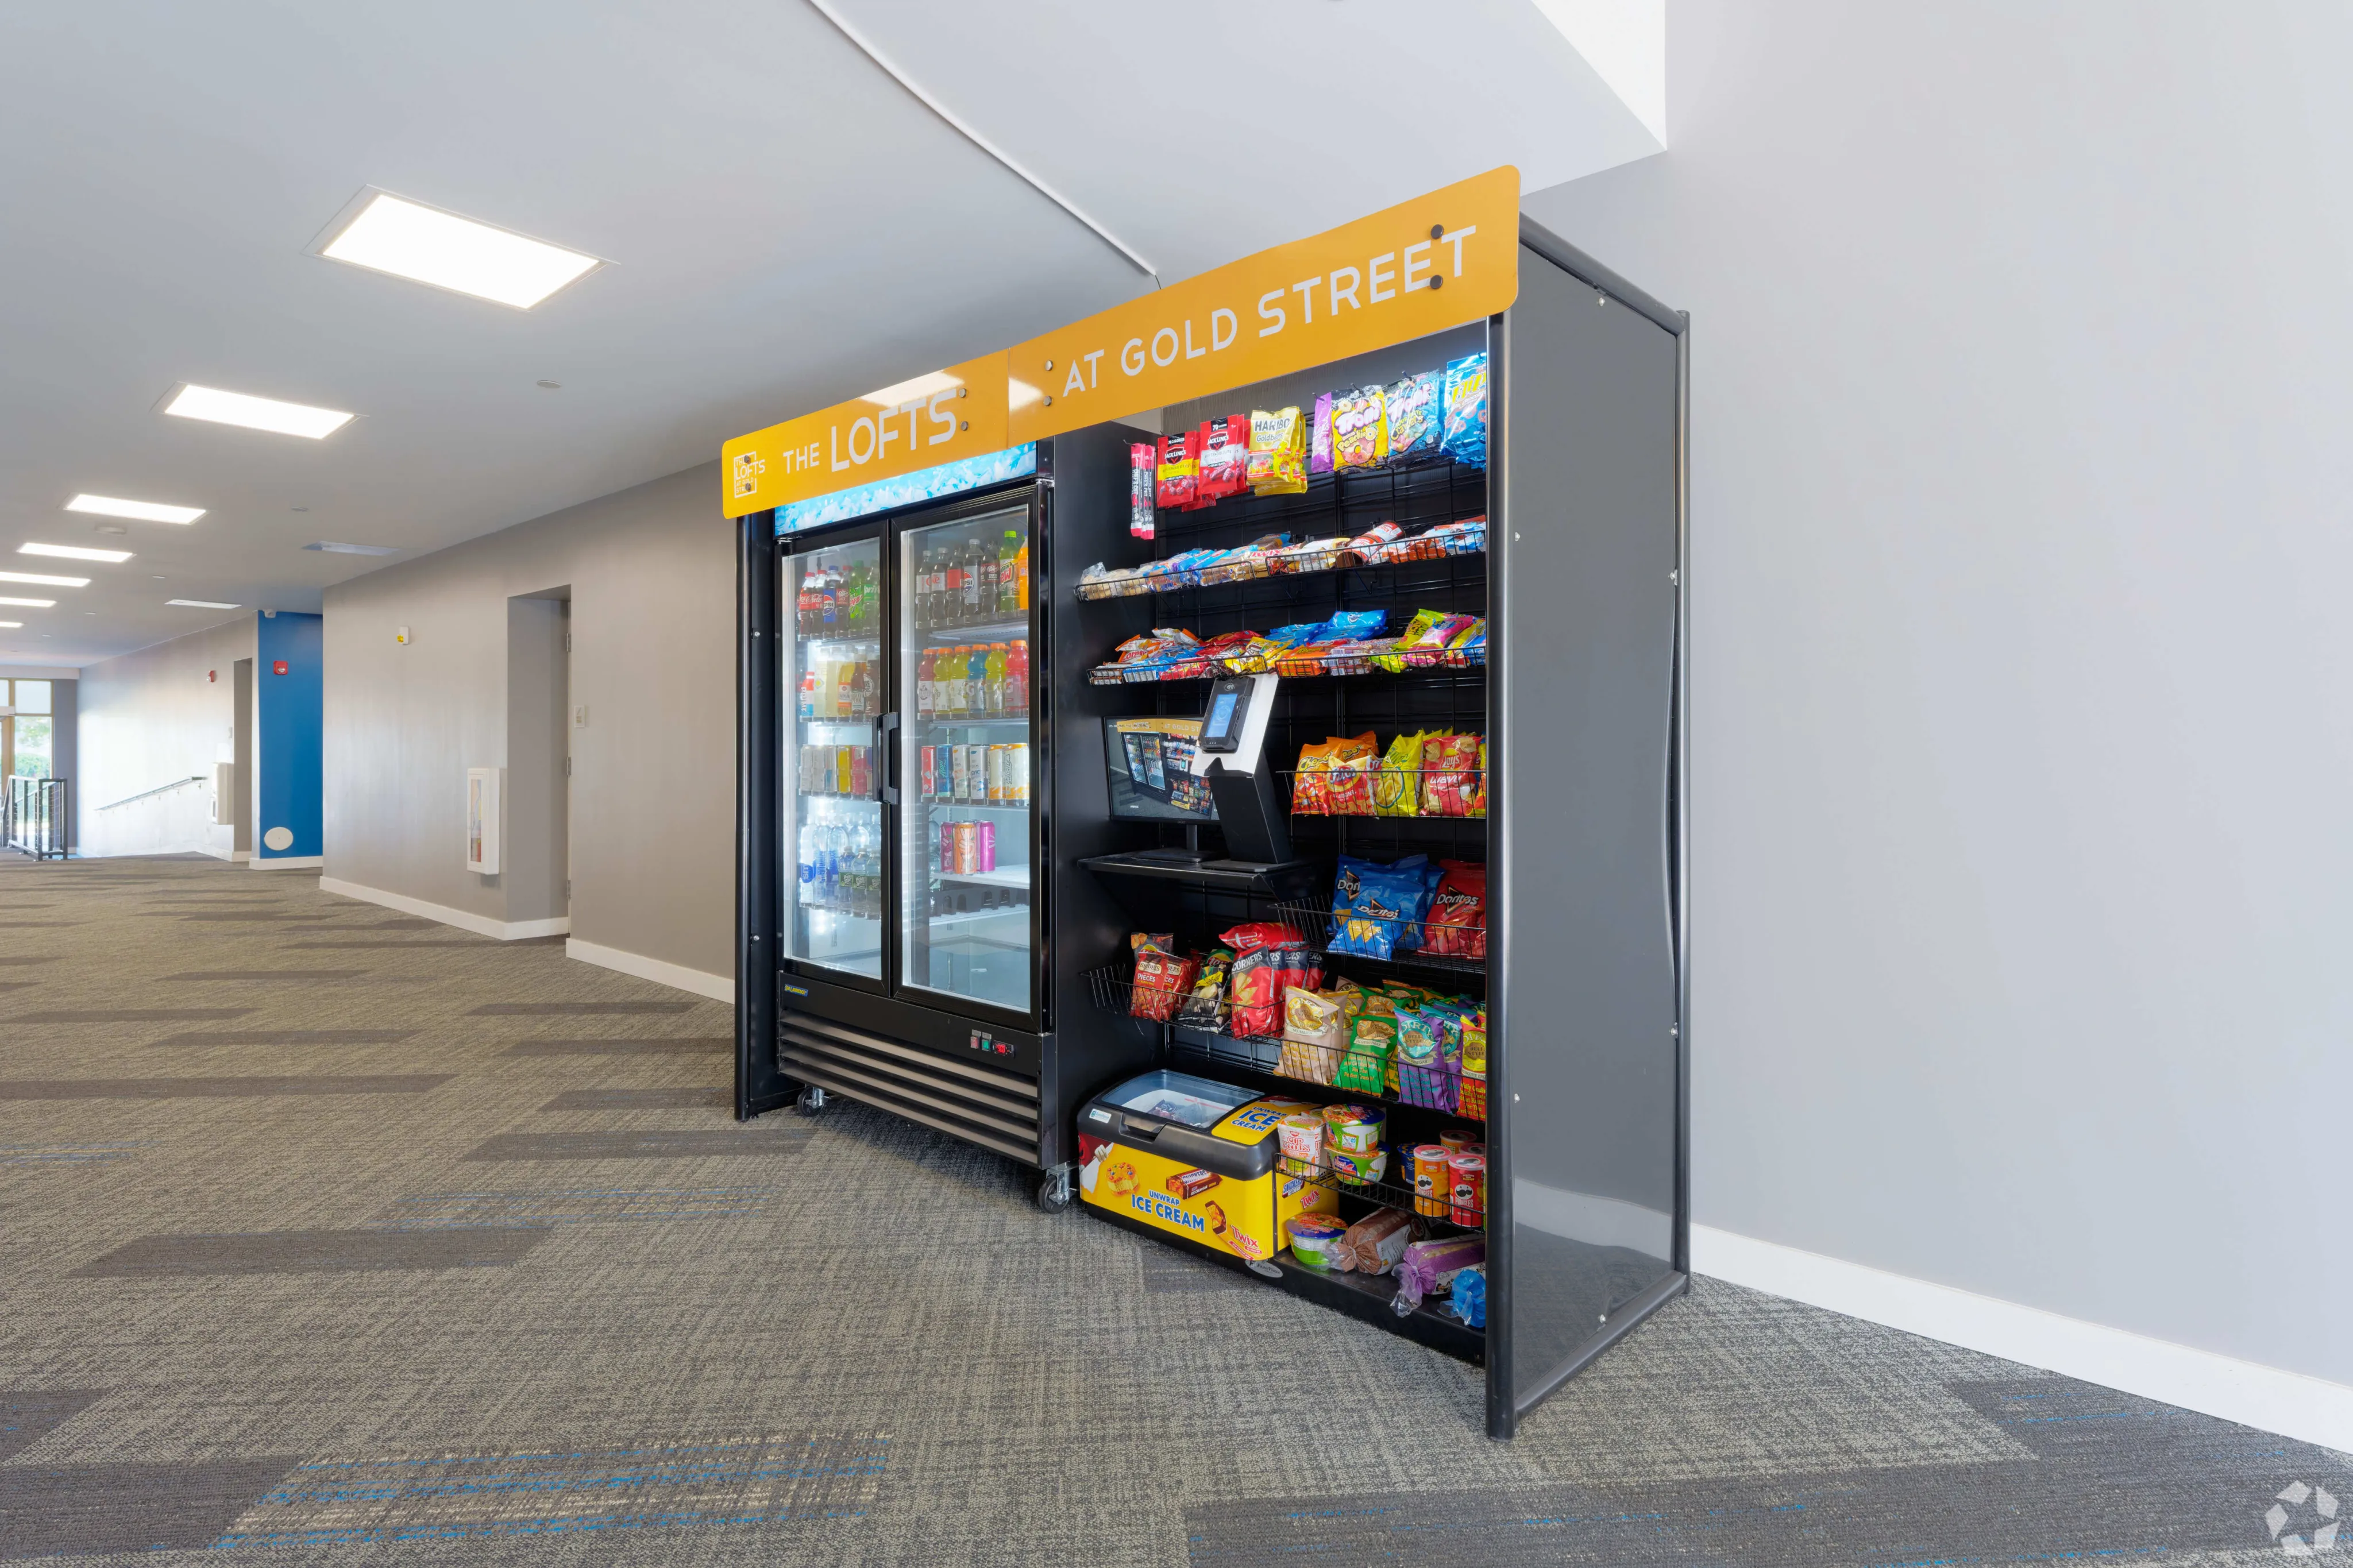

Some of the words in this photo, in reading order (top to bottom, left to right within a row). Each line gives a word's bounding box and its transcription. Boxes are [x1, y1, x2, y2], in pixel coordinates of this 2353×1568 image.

[782, 442, 820, 474] THE
[831, 388, 958, 473] LOFTS
[1063, 349, 1105, 397] AT
[1120, 307, 1238, 377] GOLD
[1257, 225, 1477, 338] STREET
[1334, 396, 1383, 435] Trolli
[1254, 418, 1291, 432] HARIBO
[735, 459, 766, 480] LOFTS
[1442, 755, 1460, 770] Lay's
[1337, 878, 1361, 891] Dori
[1437, 893, 1480, 905] Doritos
[1357, 905, 1400, 919] Doritos
[1232, 951, 1263, 972] CORNERS
[1137, 972, 1156, 983] PIECES
[1401, 1021, 1434, 1041] DIRTY
[1238, 1109, 1282, 1126] ICE
[1253, 1106, 1287, 1118] UNWRAP
[1230, 1119, 1266, 1133] CREAM
[1282, 1141, 1310, 1153] NOODLES
[1287, 1136, 1304, 1144] CUP
[1148, 1189, 1181, 1206] UNWRAP
[1300, 1189, 1320, 1209] Twix
[1455, 1196, 1473, 1208] PRINGLES
[1131, 1194, 1152, 1214] ICE
[1155, 1203, 1205, 1233] CREAM
[1230, 1224, 1259, 1248] Twix
